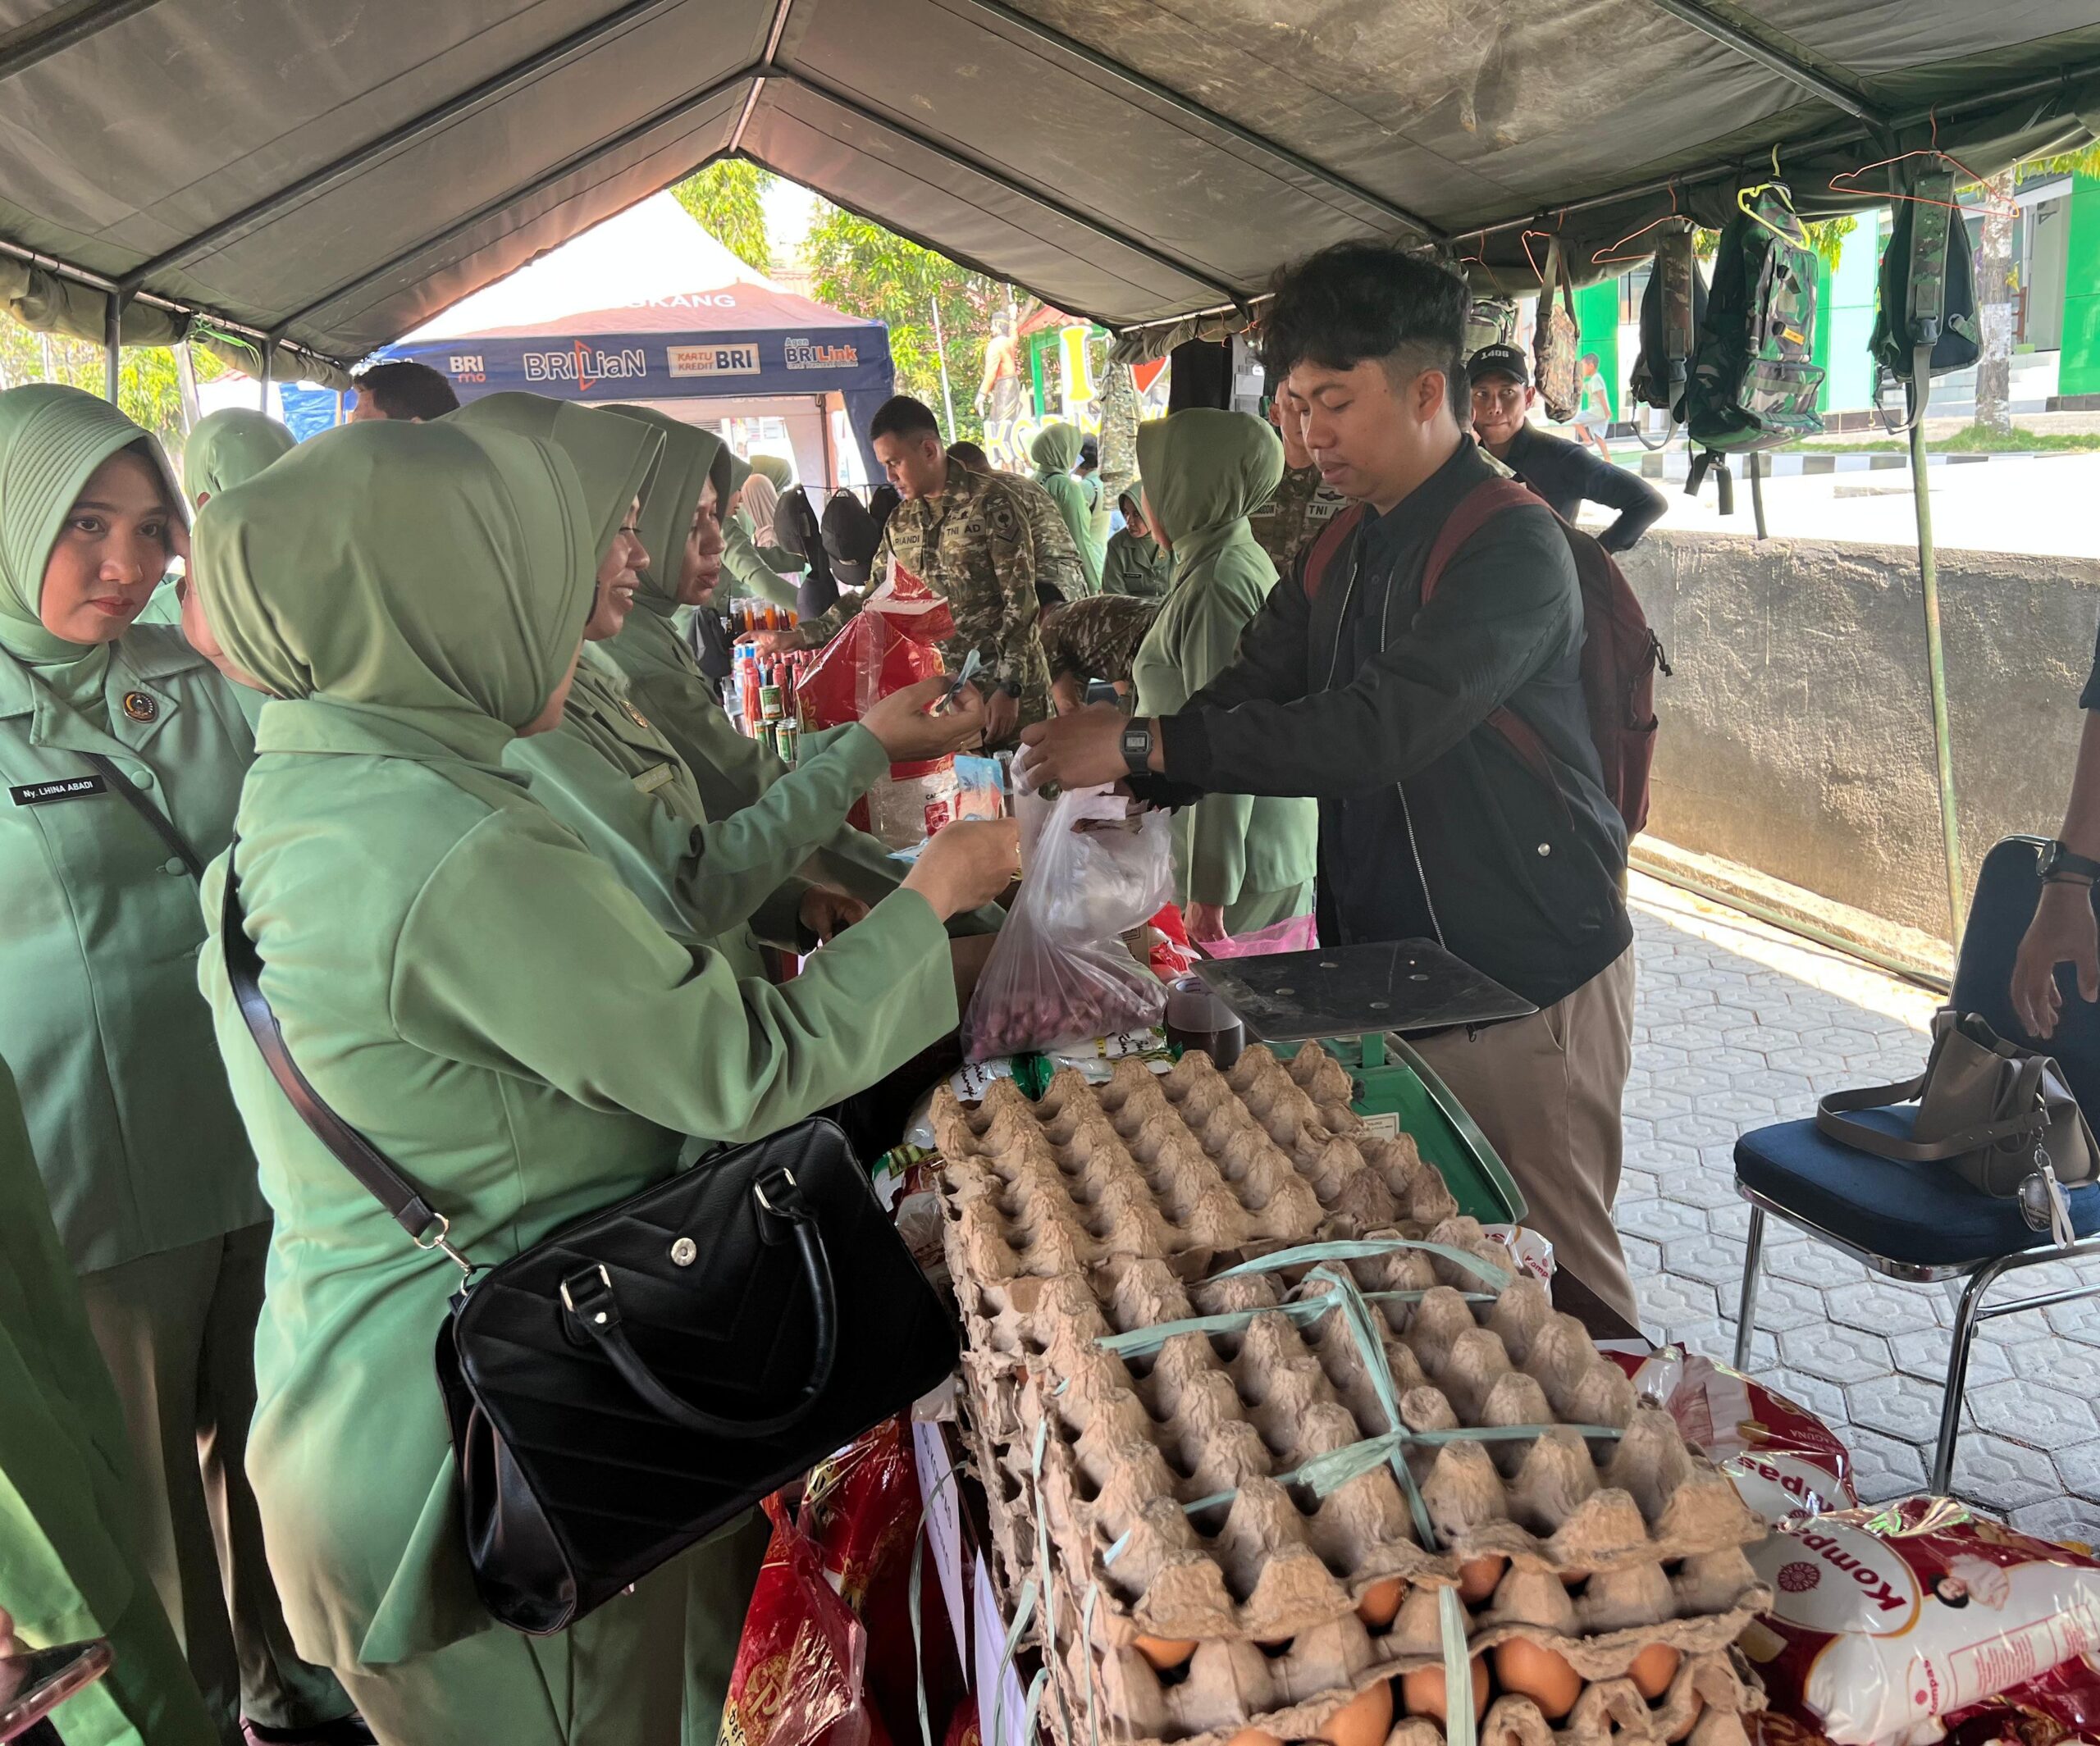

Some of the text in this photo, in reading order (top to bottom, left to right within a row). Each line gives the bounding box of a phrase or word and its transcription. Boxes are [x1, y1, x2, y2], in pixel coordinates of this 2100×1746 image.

[678, 352, 712, 362] KARTU
[716, 350, 752, 369] BRI
[785, 345, 858, 362] BRILink
[450, 355, 484, 372] BRI
[678, 362, 714, 371] KREDIT
[459, 373, 486, 383] mo
[1309, 505, 1327, 515] TNI
[947, 524, 981, 536] TNI AD
[23, 781, 94, 799] Ny. LHINA ABADI
[1525, 1255, 1550, 1279] Komp
[1737, 1456, 1835, 1512] mpas
[1790, 1528, 1907, 1612] Komp
